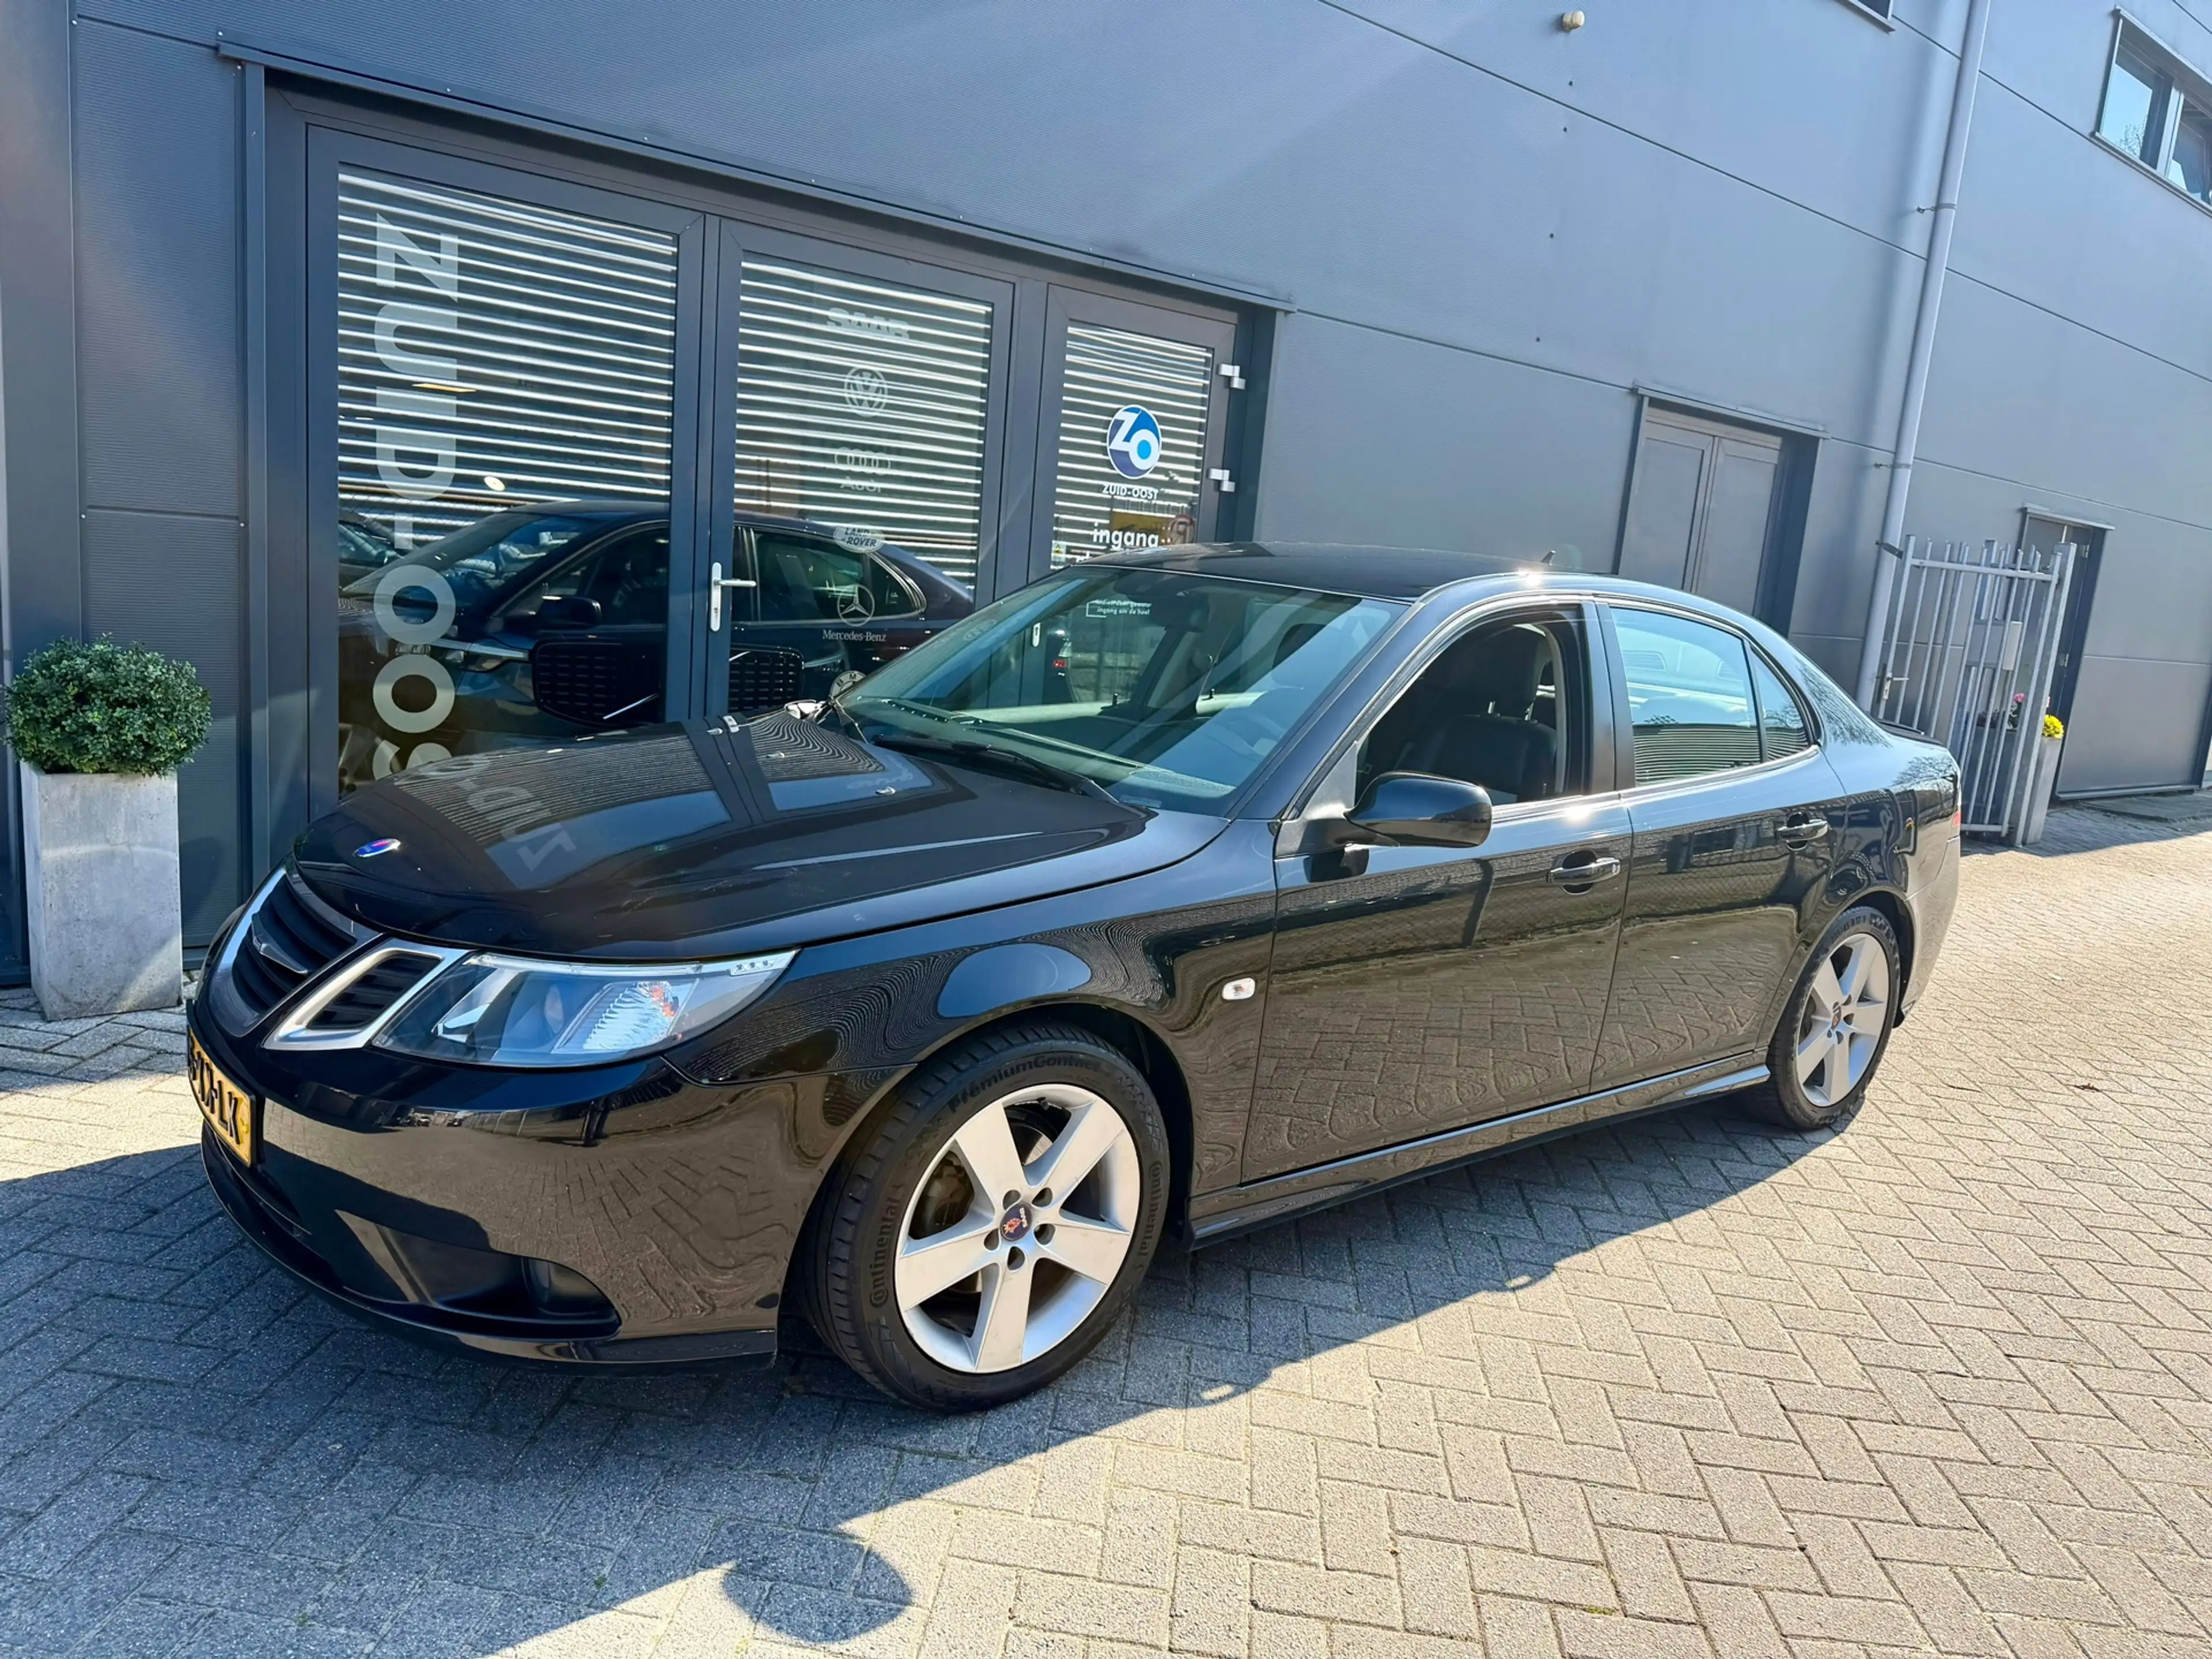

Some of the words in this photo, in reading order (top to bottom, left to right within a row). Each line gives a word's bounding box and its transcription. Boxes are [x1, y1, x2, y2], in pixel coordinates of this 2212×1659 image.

[840, 476, 882, 493] Audi
[1101, 483, 1159, 500] ZUID-OOST
[844, 527, 871, 537] LAND
[846, 537, 877, 547] ROVER
[822, 629, 887, 643] Mercedes-Benz
[1139, 1160, 1163, 1259] Continental
[869, 1196, 900, 1310] Continental
